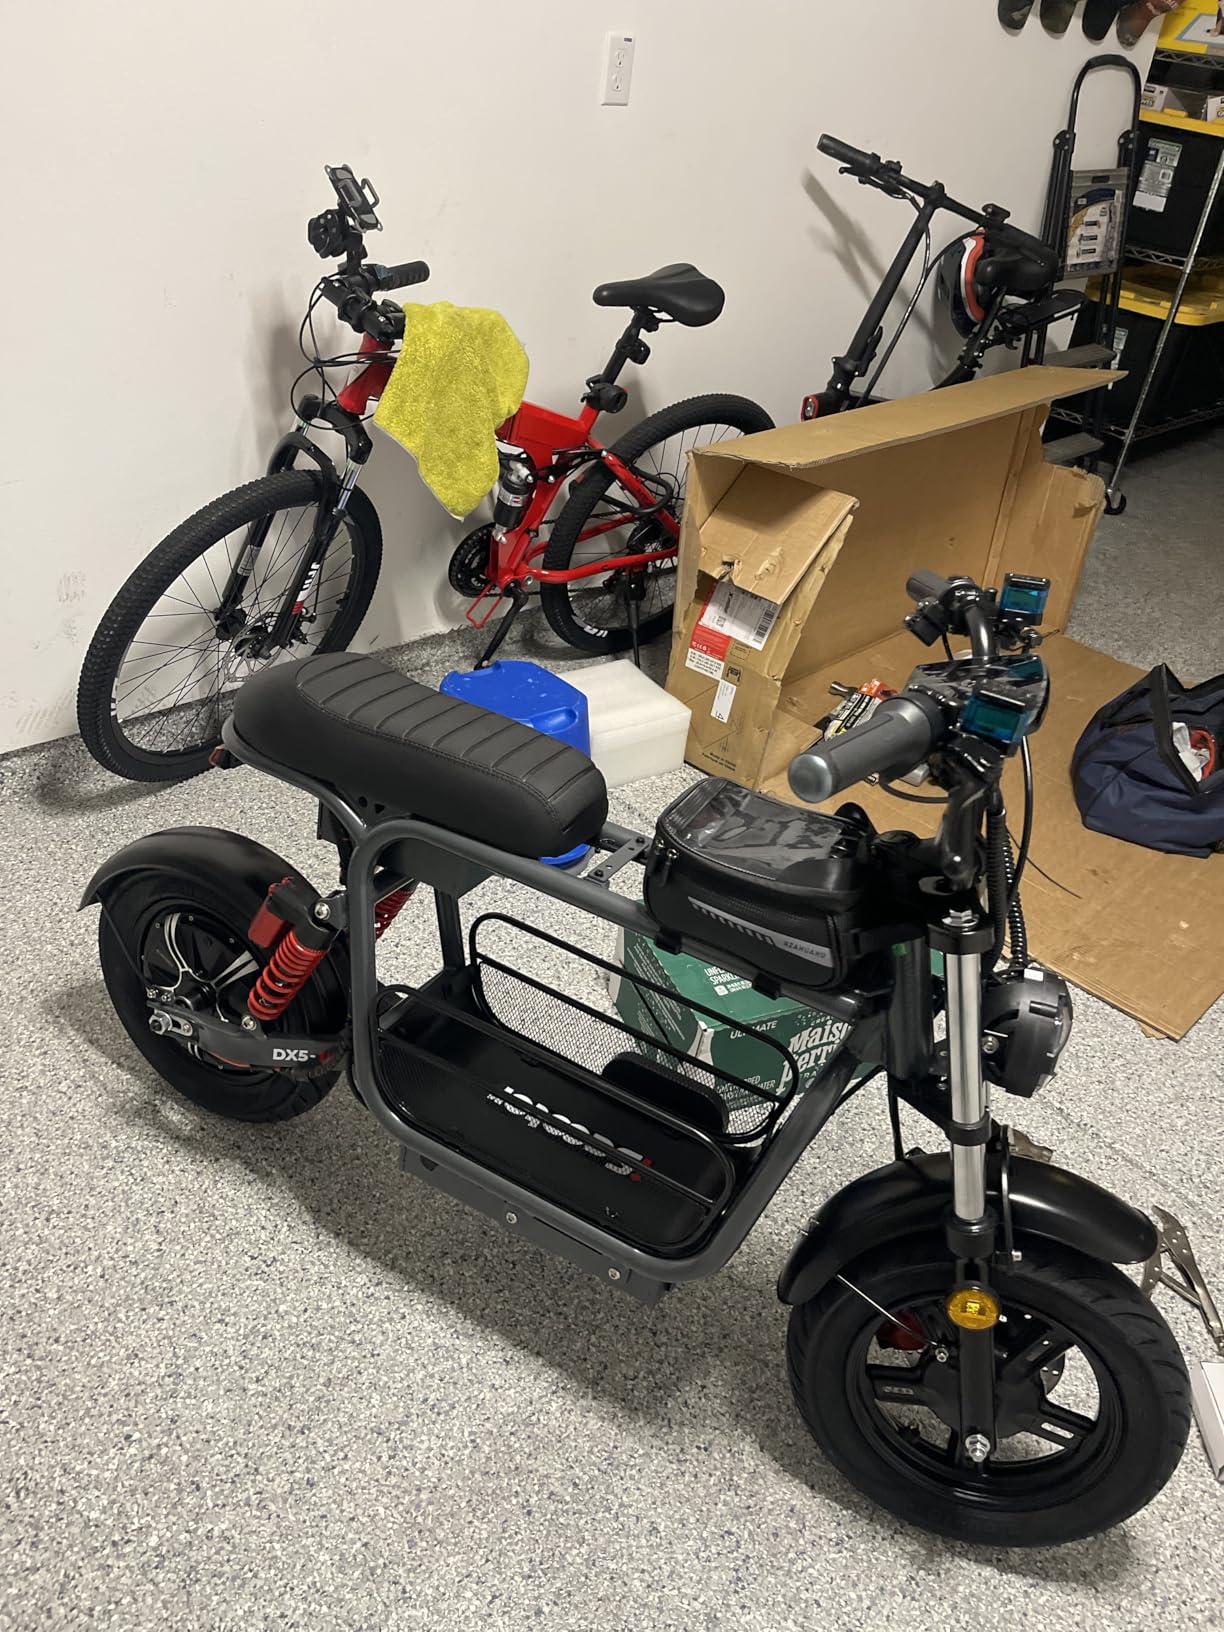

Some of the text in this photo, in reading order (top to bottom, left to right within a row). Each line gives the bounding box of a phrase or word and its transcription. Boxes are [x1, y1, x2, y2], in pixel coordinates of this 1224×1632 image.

[709, 972, 740, 985] SPARKL
[730, 1020, 778, 1039] ULMATE
[788, 1019, 853, 1055] Mais
